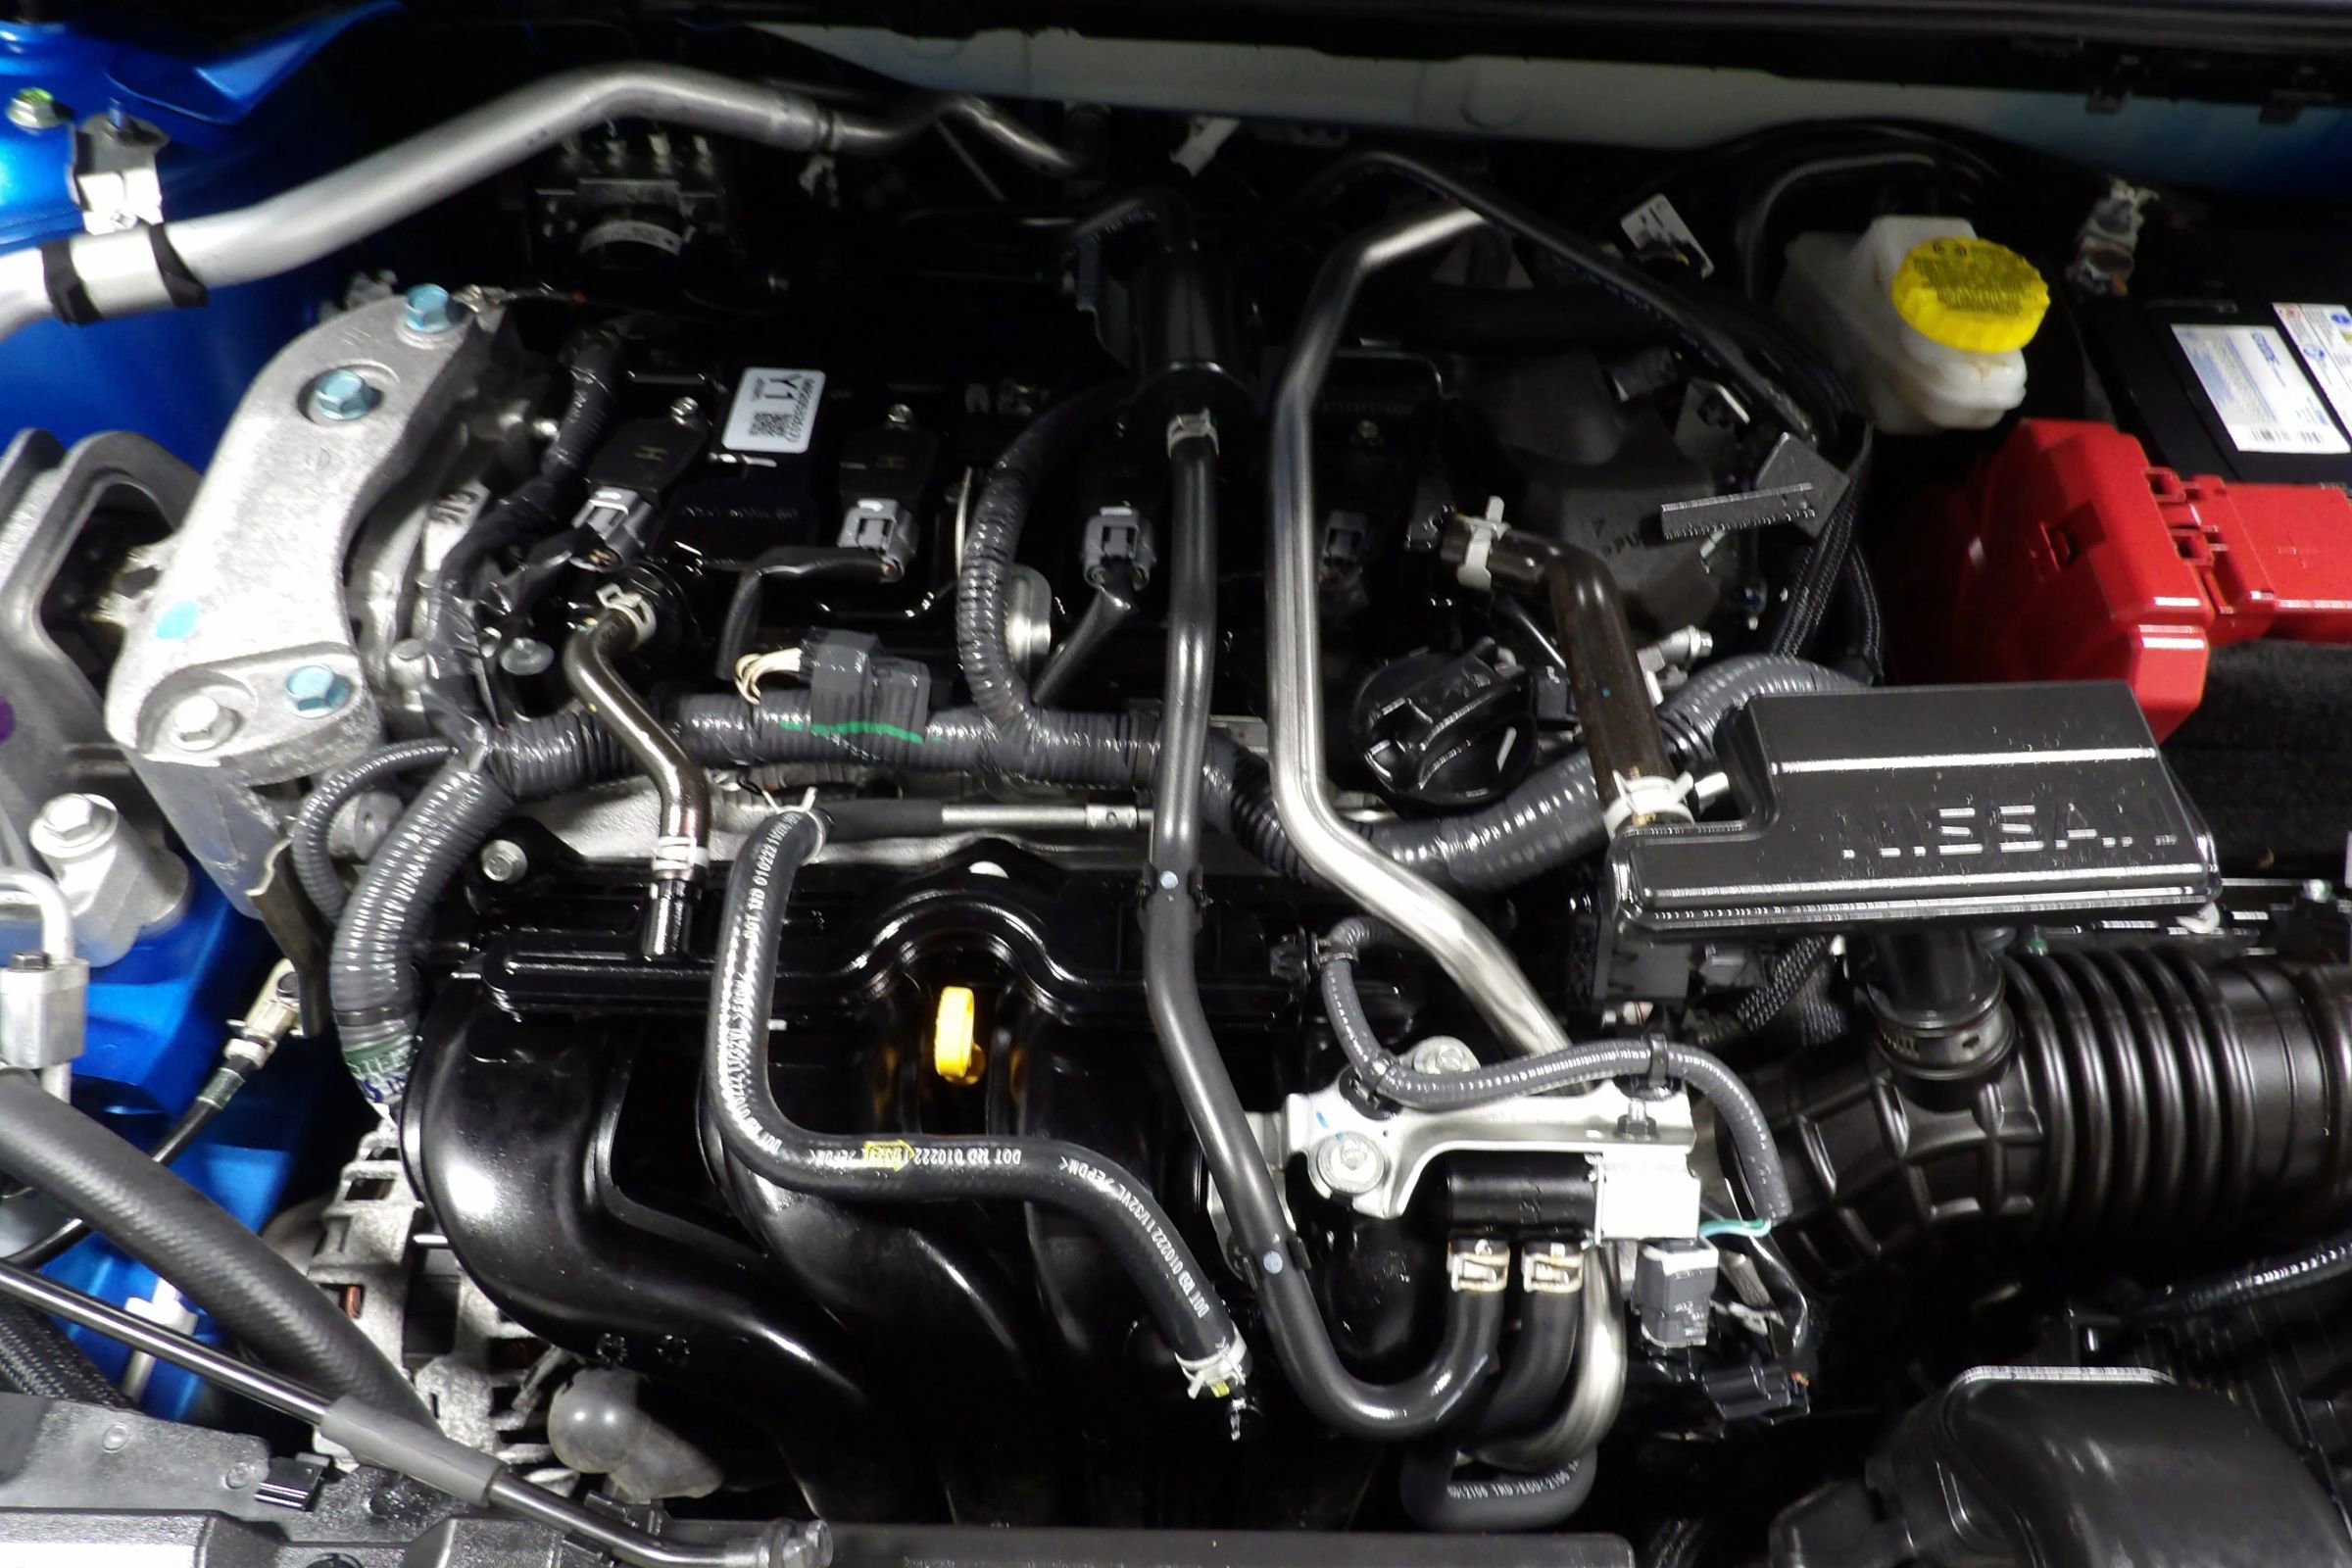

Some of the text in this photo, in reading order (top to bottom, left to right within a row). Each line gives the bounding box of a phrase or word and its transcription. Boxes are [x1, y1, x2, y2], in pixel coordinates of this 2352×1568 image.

[913, 1147, 965, 1166] 010222
[994, 1148, 1022, 1165] DOT
[1151, 1226, 1184, 1275] 010222
[1189, 1290, 1210, 1319] DOT
